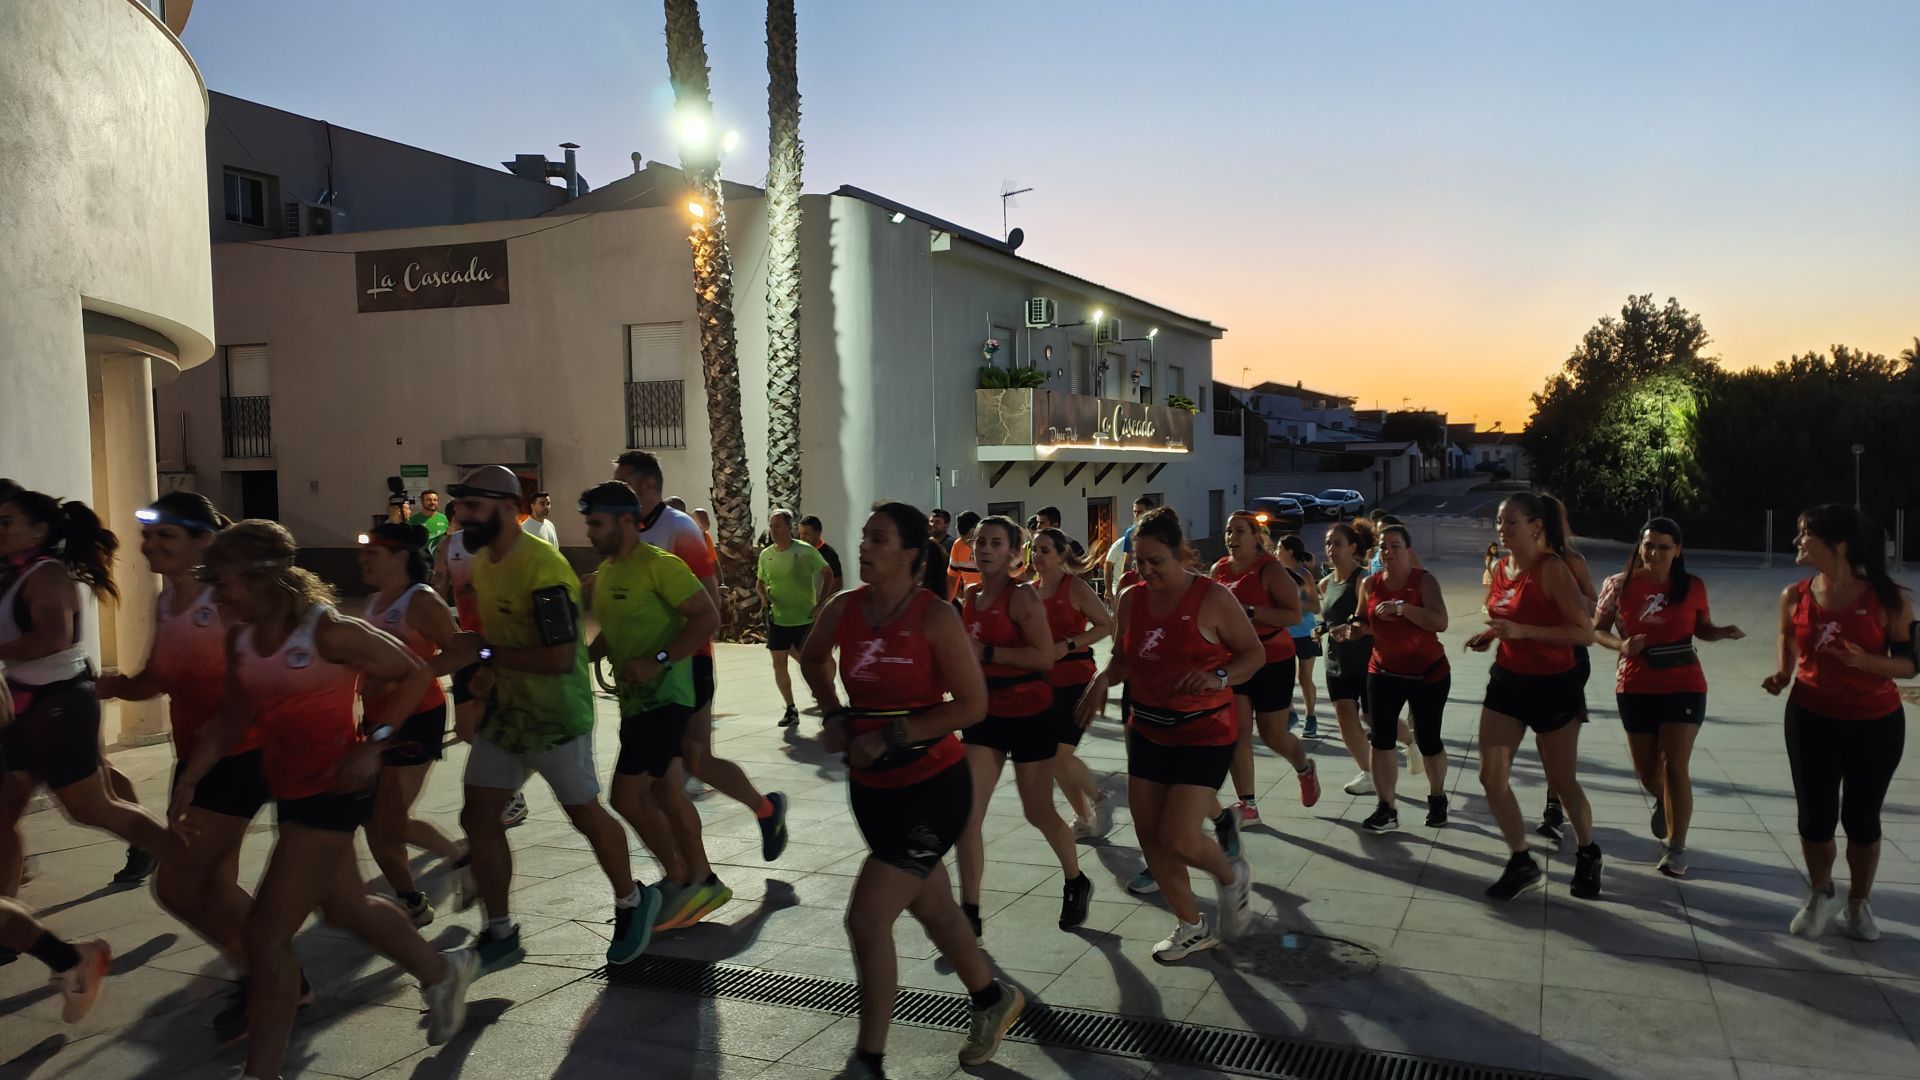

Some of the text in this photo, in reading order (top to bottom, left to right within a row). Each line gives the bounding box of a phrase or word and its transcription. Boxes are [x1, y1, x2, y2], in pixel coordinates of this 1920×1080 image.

[366, 256, 493, 299] La Cascada
[1092, 399, 1155, 446] La Cascada
